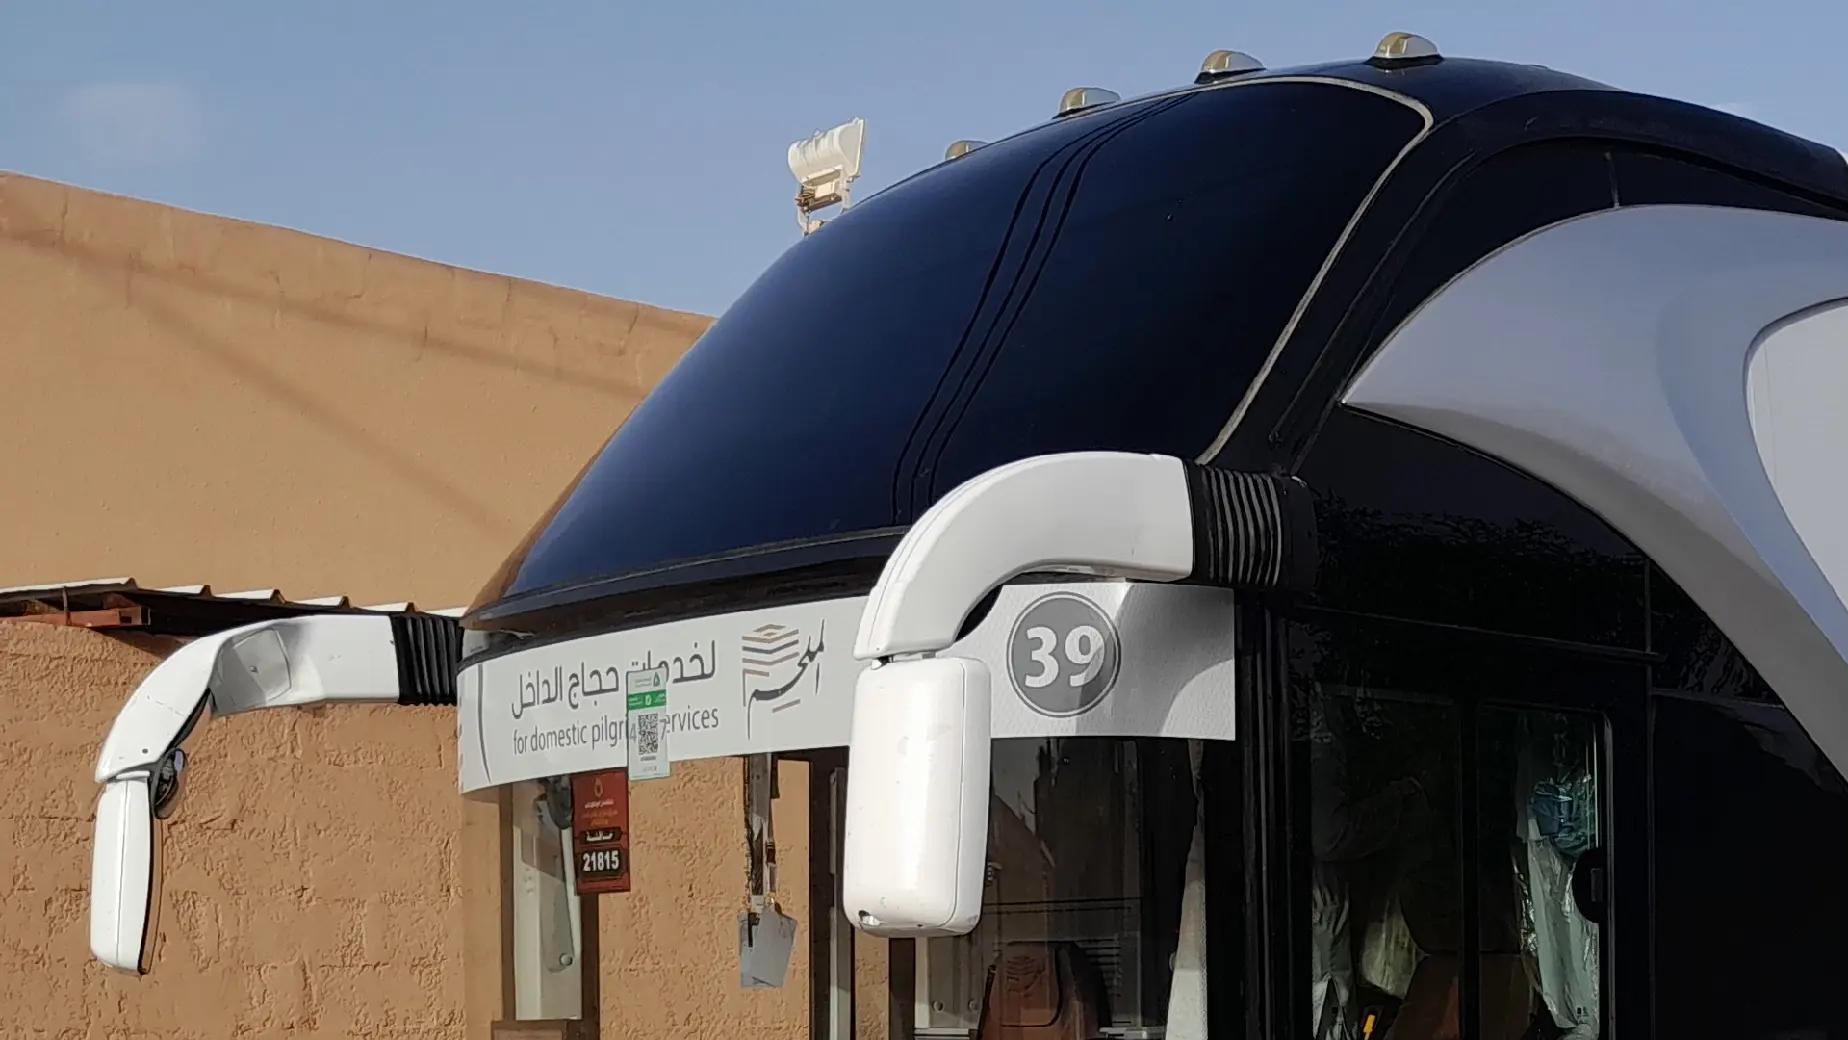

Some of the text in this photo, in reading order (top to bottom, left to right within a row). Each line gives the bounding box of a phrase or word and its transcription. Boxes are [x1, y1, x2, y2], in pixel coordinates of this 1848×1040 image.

[1025, 625, 1105, 688] 39
[511, 666, 563, 720] الداخل
[567, 661, 620, 710] حجاج
[513, 704, 719, 755] for domestic pilgr ervices
[582, 850, 620, 872] 21815
